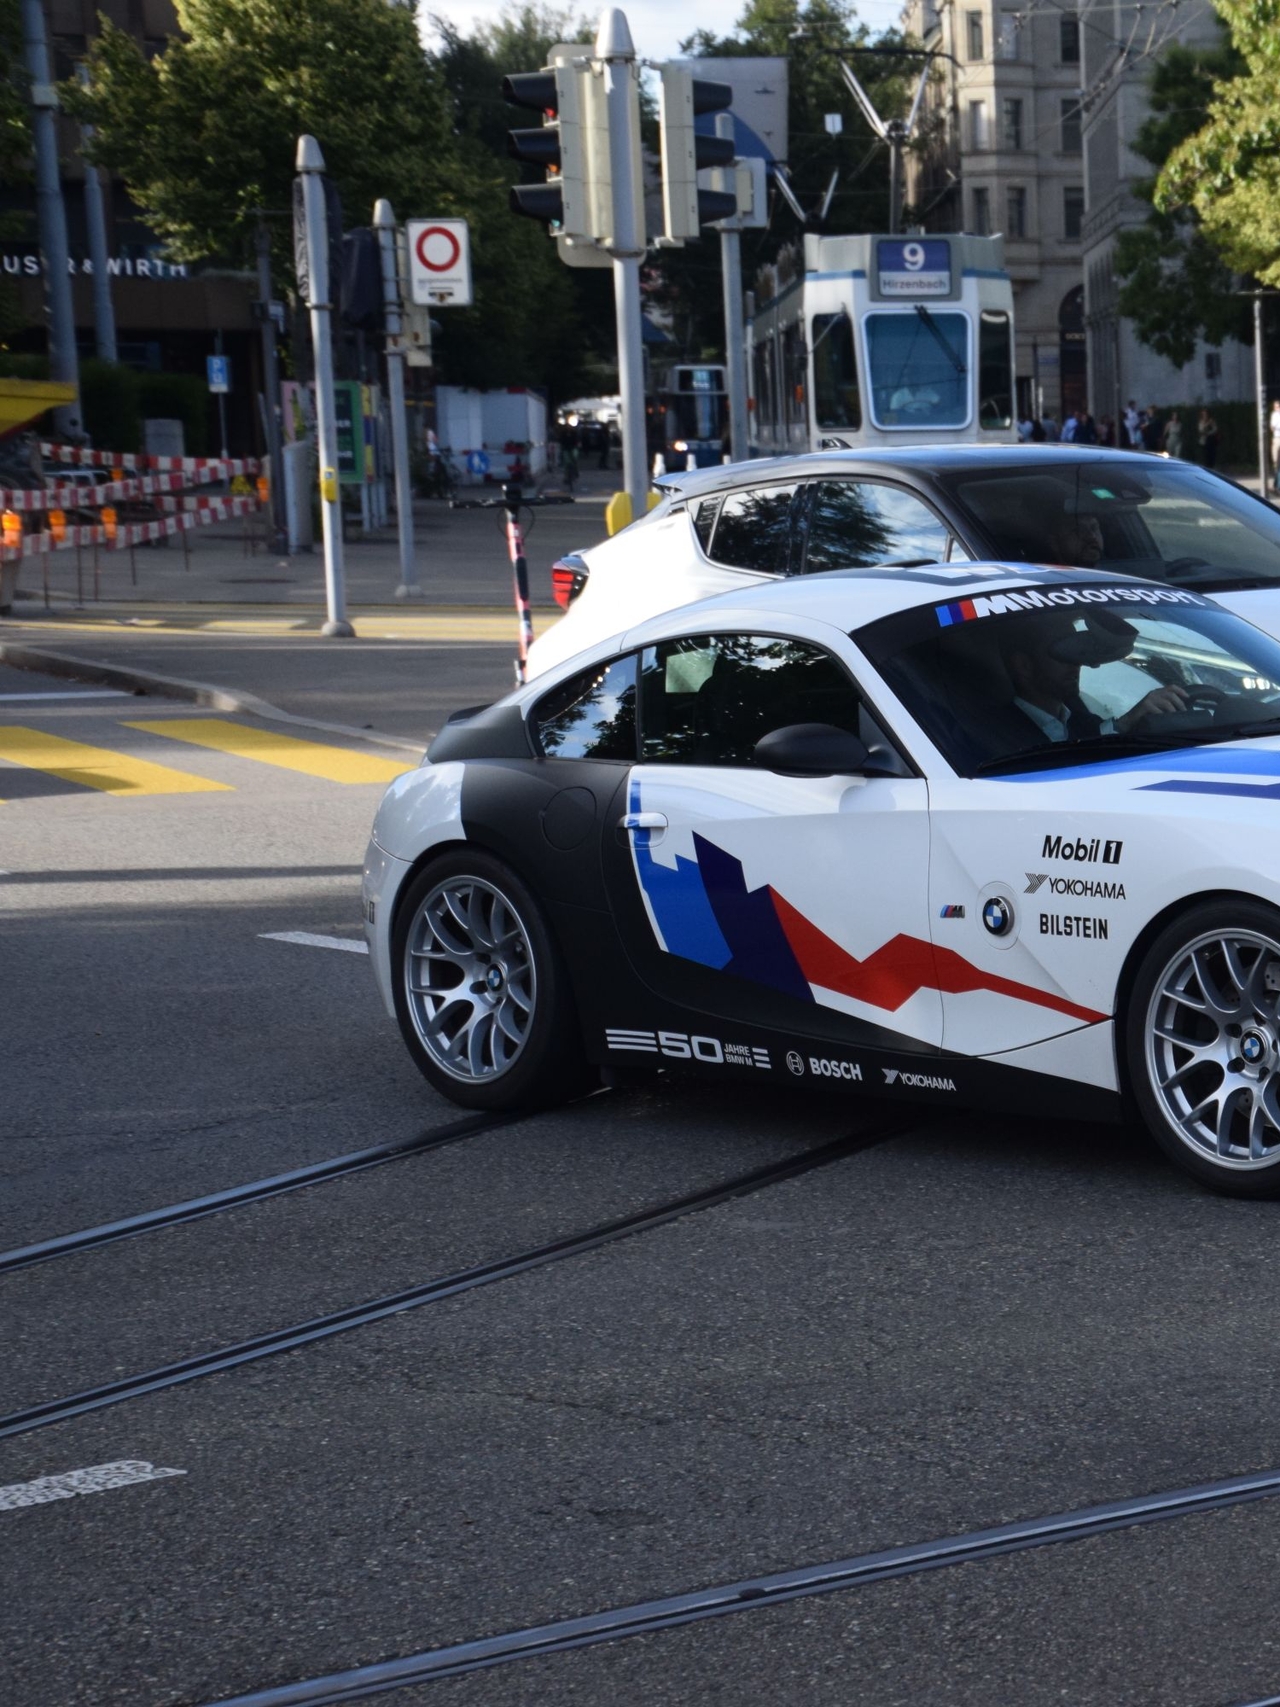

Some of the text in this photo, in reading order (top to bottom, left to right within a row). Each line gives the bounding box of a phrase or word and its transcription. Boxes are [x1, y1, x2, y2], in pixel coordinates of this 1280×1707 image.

[0, 255, 76, 275] USR
[903, 242, 925, 271] 9
[883, 279, 946, 289] Hirzenbach
[1041, 834, 1101, 863] Mobil
[1048, 877, 1126, 900] YOKOHAMA
[1039, 913, 1109, 940] BILSTEIN
[657, 1031, 724, 1064] 50
[724, 1043, 750, 1056] JAHRE
[725, 1054, 753, 1066] BMW M
[809, 1057, 863, 1081] BOSCH
[899, 1071, 957, 1092] YOKOHAMA
